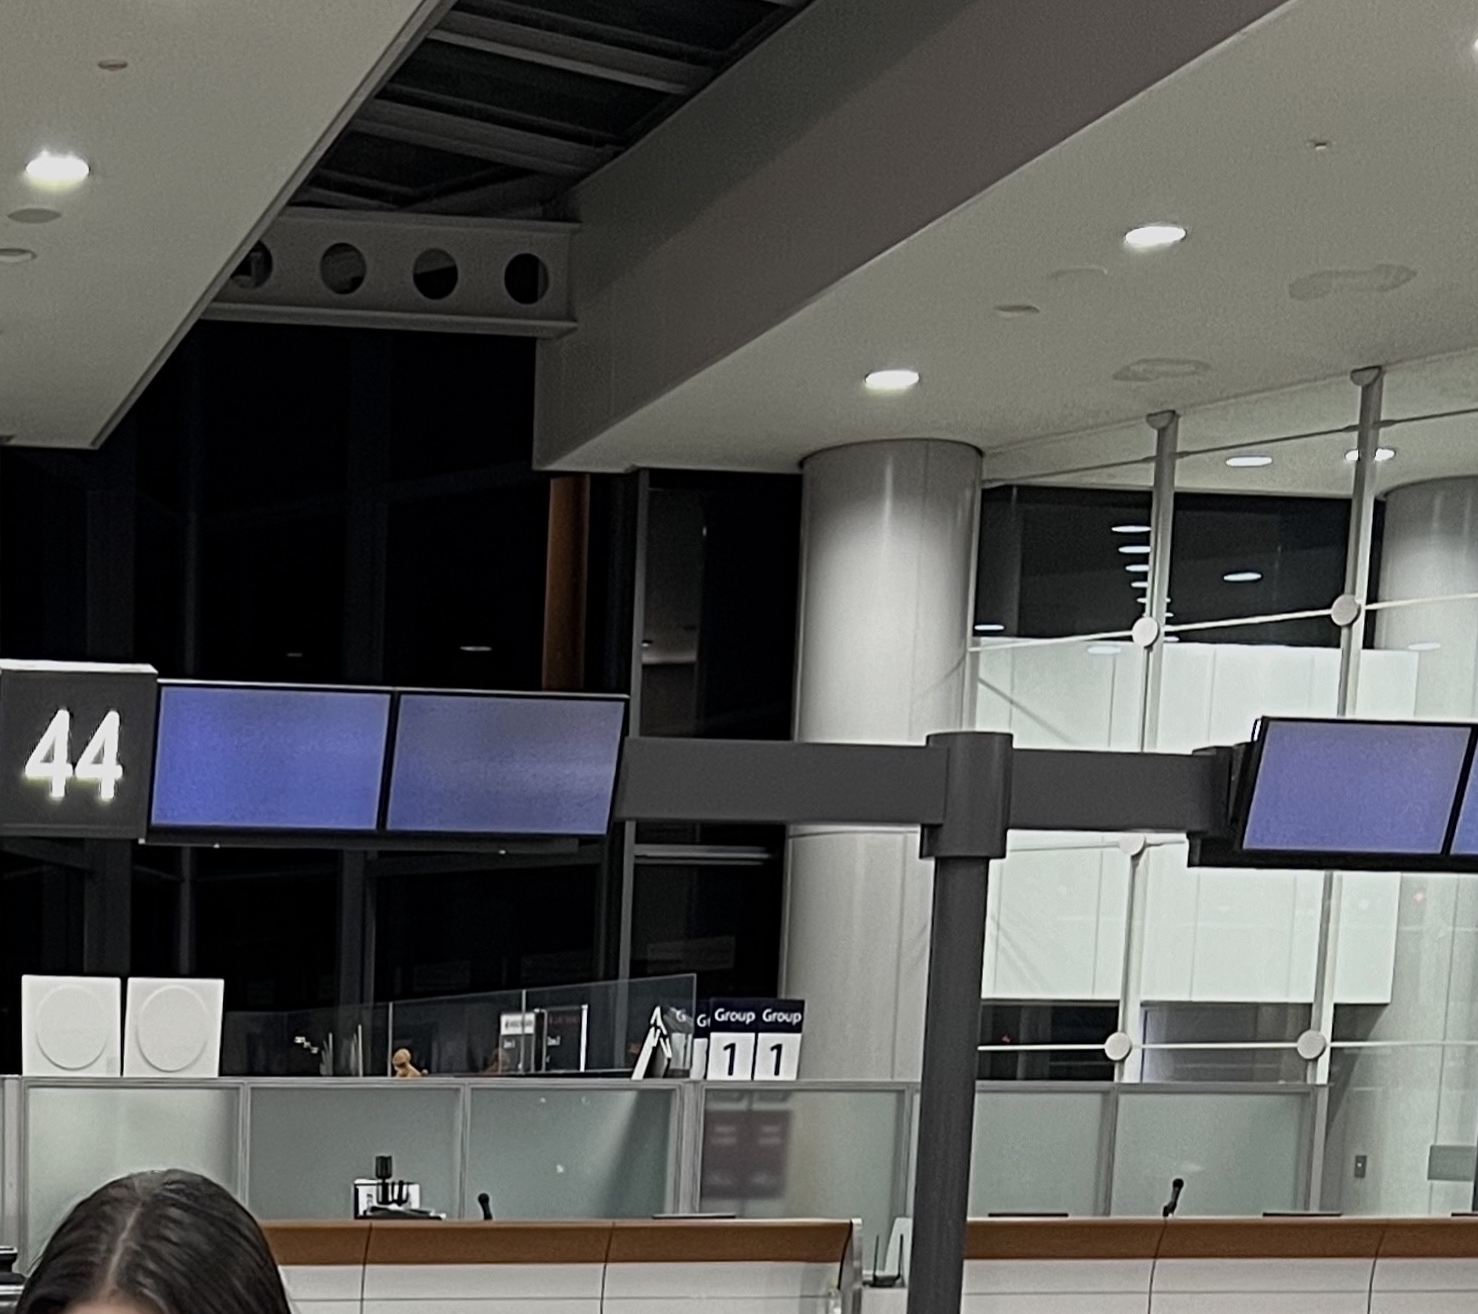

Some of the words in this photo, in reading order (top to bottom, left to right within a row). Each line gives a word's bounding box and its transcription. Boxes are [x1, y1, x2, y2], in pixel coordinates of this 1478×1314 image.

[24, 707, 124, 801] 44
[714, 1007, 756, 1025] Group
[762, 1008, 802, 1026] Group
[723, 1042, 736, 1077] 1
[770, 1043, 783, 1077] 1
